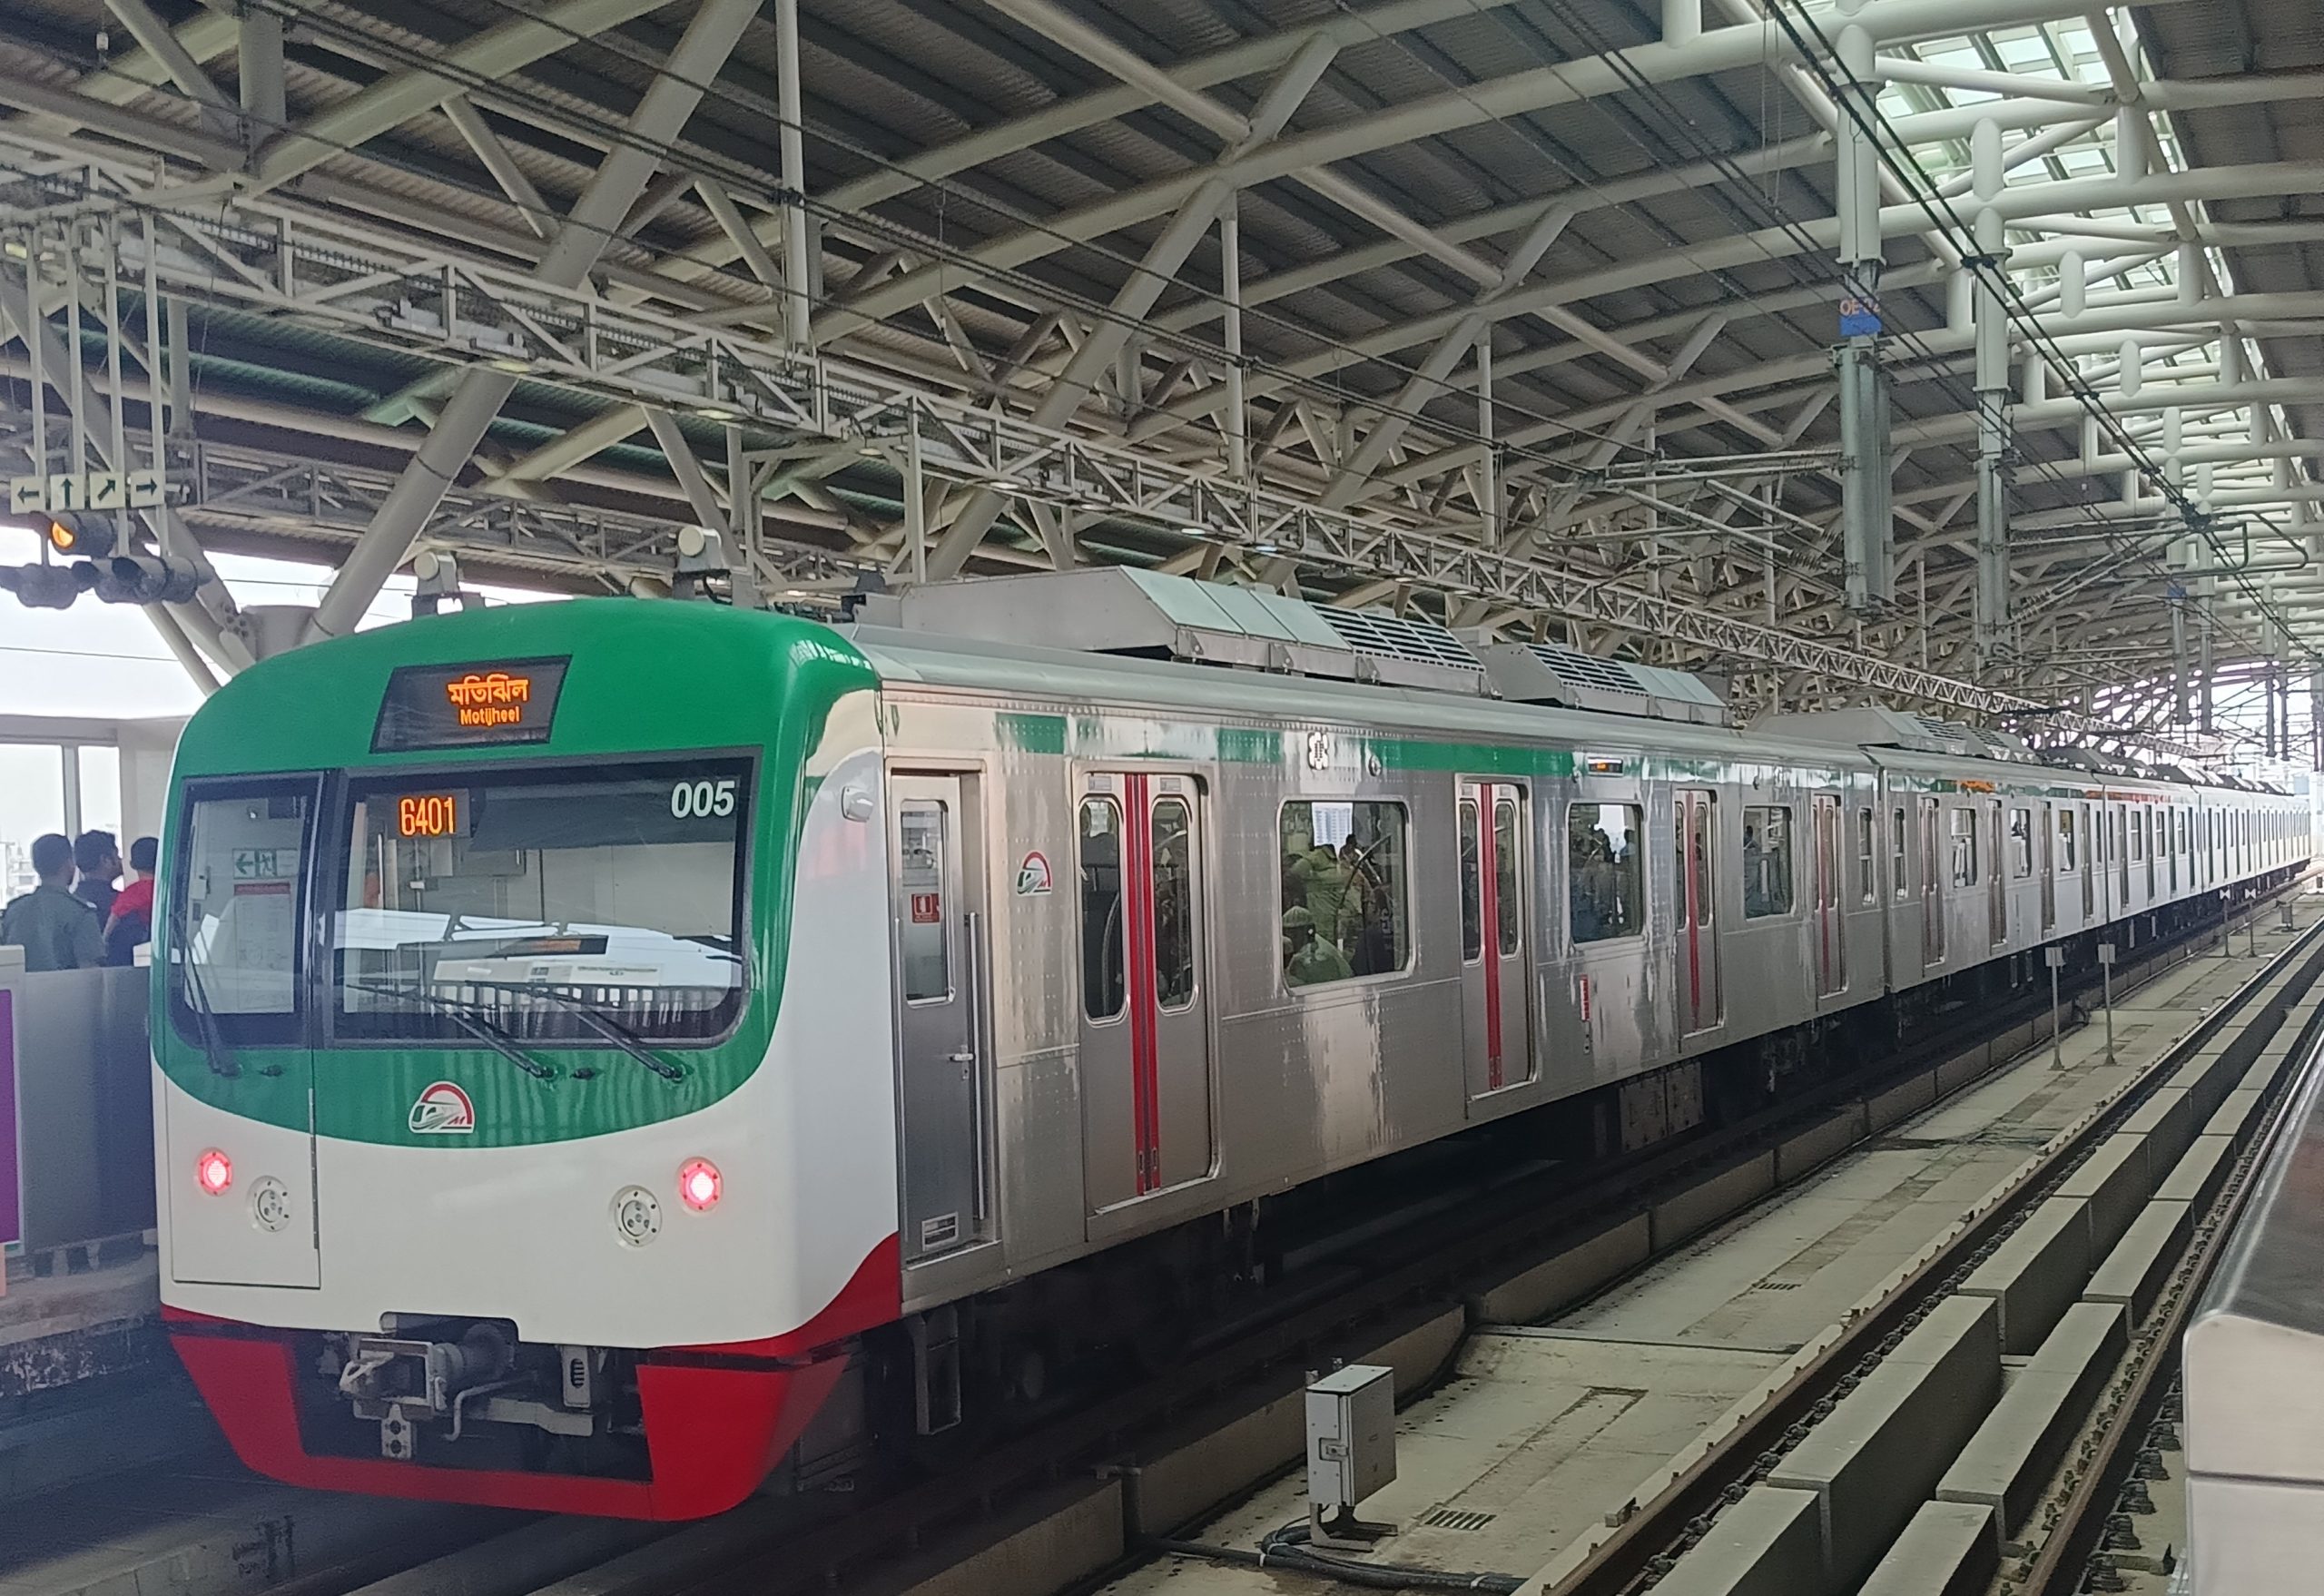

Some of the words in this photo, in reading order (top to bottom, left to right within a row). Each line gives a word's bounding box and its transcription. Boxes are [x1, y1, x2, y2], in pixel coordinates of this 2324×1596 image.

[448, 673, 529, 705] মতিঝিল
[460, 706, 520, 726] Motijheel
[400, 796, 454, 836] 6401
[671, 780, 735, 819] 005
